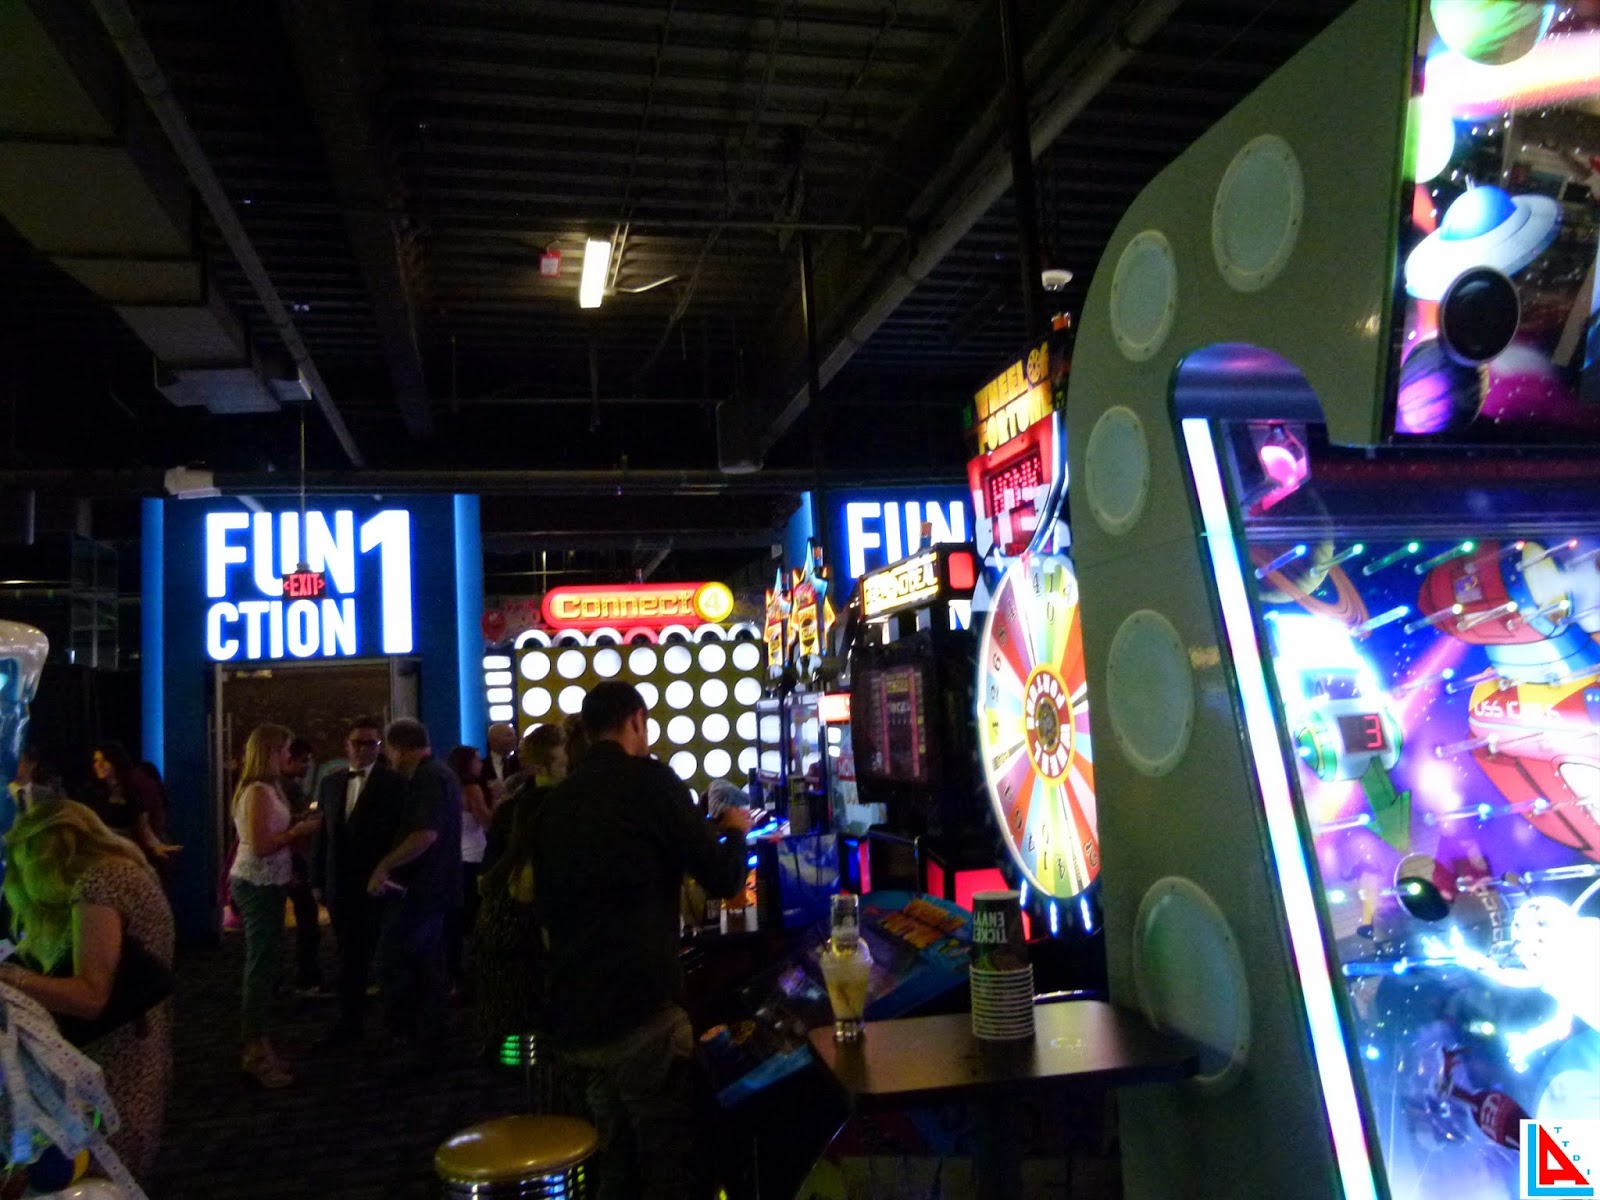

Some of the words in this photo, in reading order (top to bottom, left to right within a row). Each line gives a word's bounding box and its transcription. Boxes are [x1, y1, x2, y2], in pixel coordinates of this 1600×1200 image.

[206, 510, 355, 598] FUN
[289, 573, 320, 597] EXIT
[360, 509, 413, 654] 1
[206, 598, 357, 662] CTION
[972, 928, 1008, 944] TICKE
